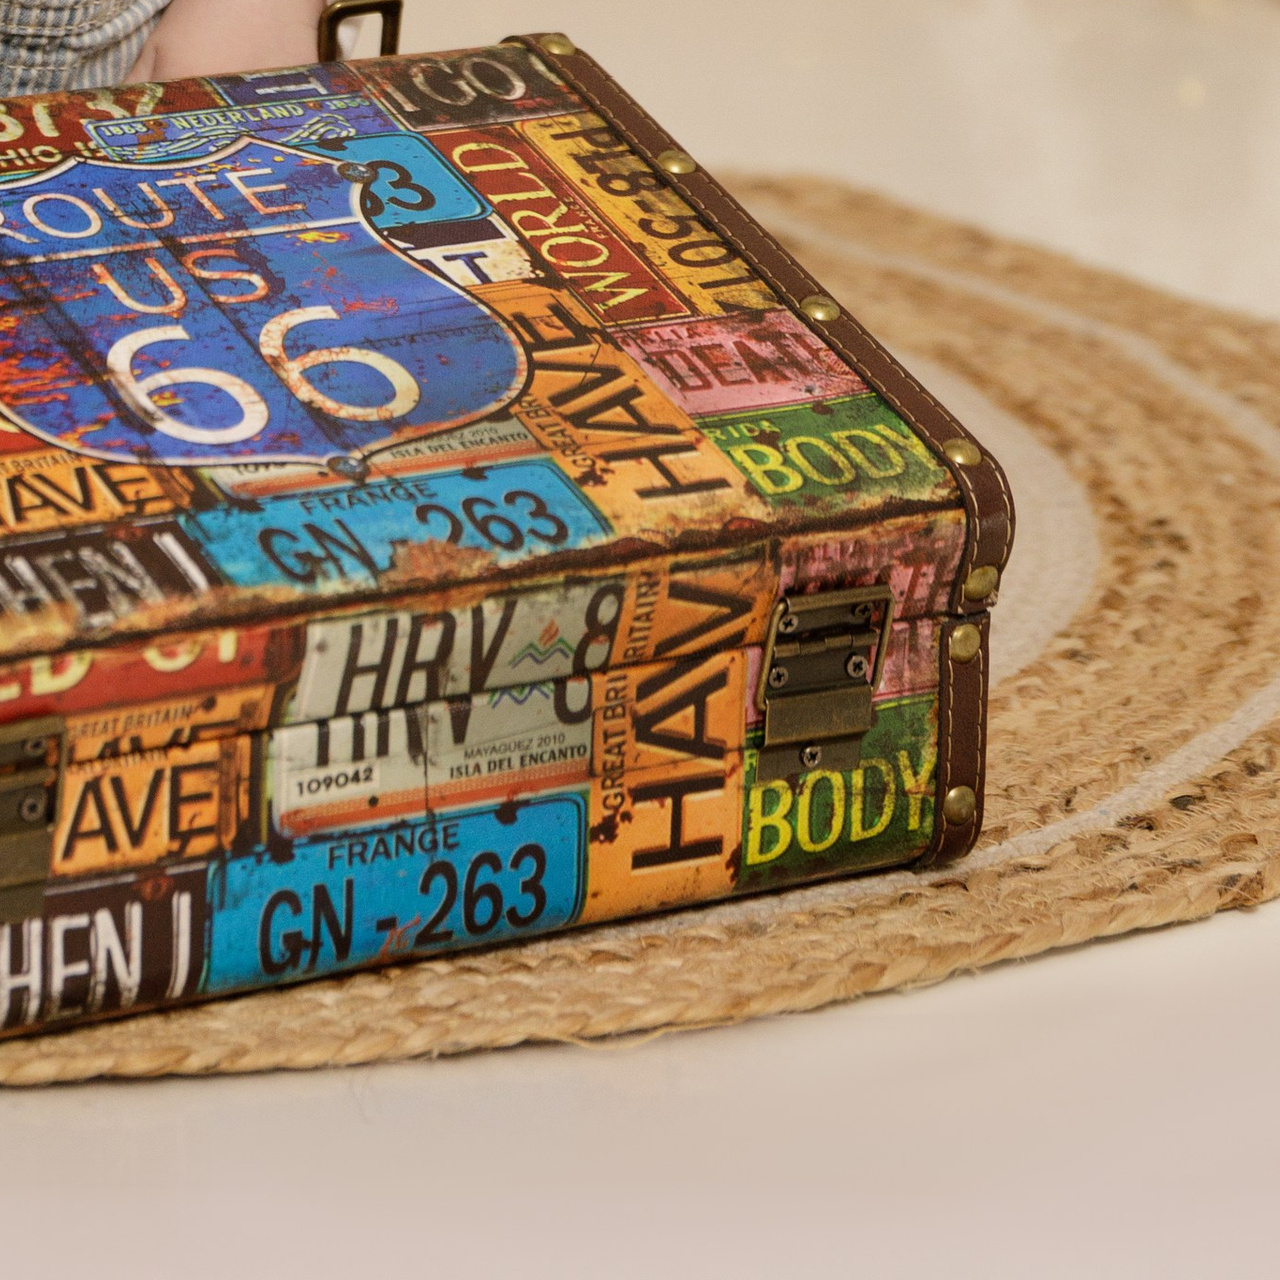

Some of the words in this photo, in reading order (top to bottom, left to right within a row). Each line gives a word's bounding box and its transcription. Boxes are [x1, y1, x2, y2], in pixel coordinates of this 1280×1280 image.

[169, 103, 305, 130] NEDERLAND
[452, 142, 650, 315] WORLD
[91, 248, 272, 316] US
[106, 305, 421, 446] 66
[511, 302, 734, 500] HAVE
[295, 767, 375, 798] 109042
[449, 762, 483, 781] ISLA
[486, 757, 516, 776] DEL
[519, 743, 588, 769] ENCANTO
[537, 732, 567, 749] 2010
[61, 761, 218, 861] AVE
[746, 749, 936, 867] BODY
